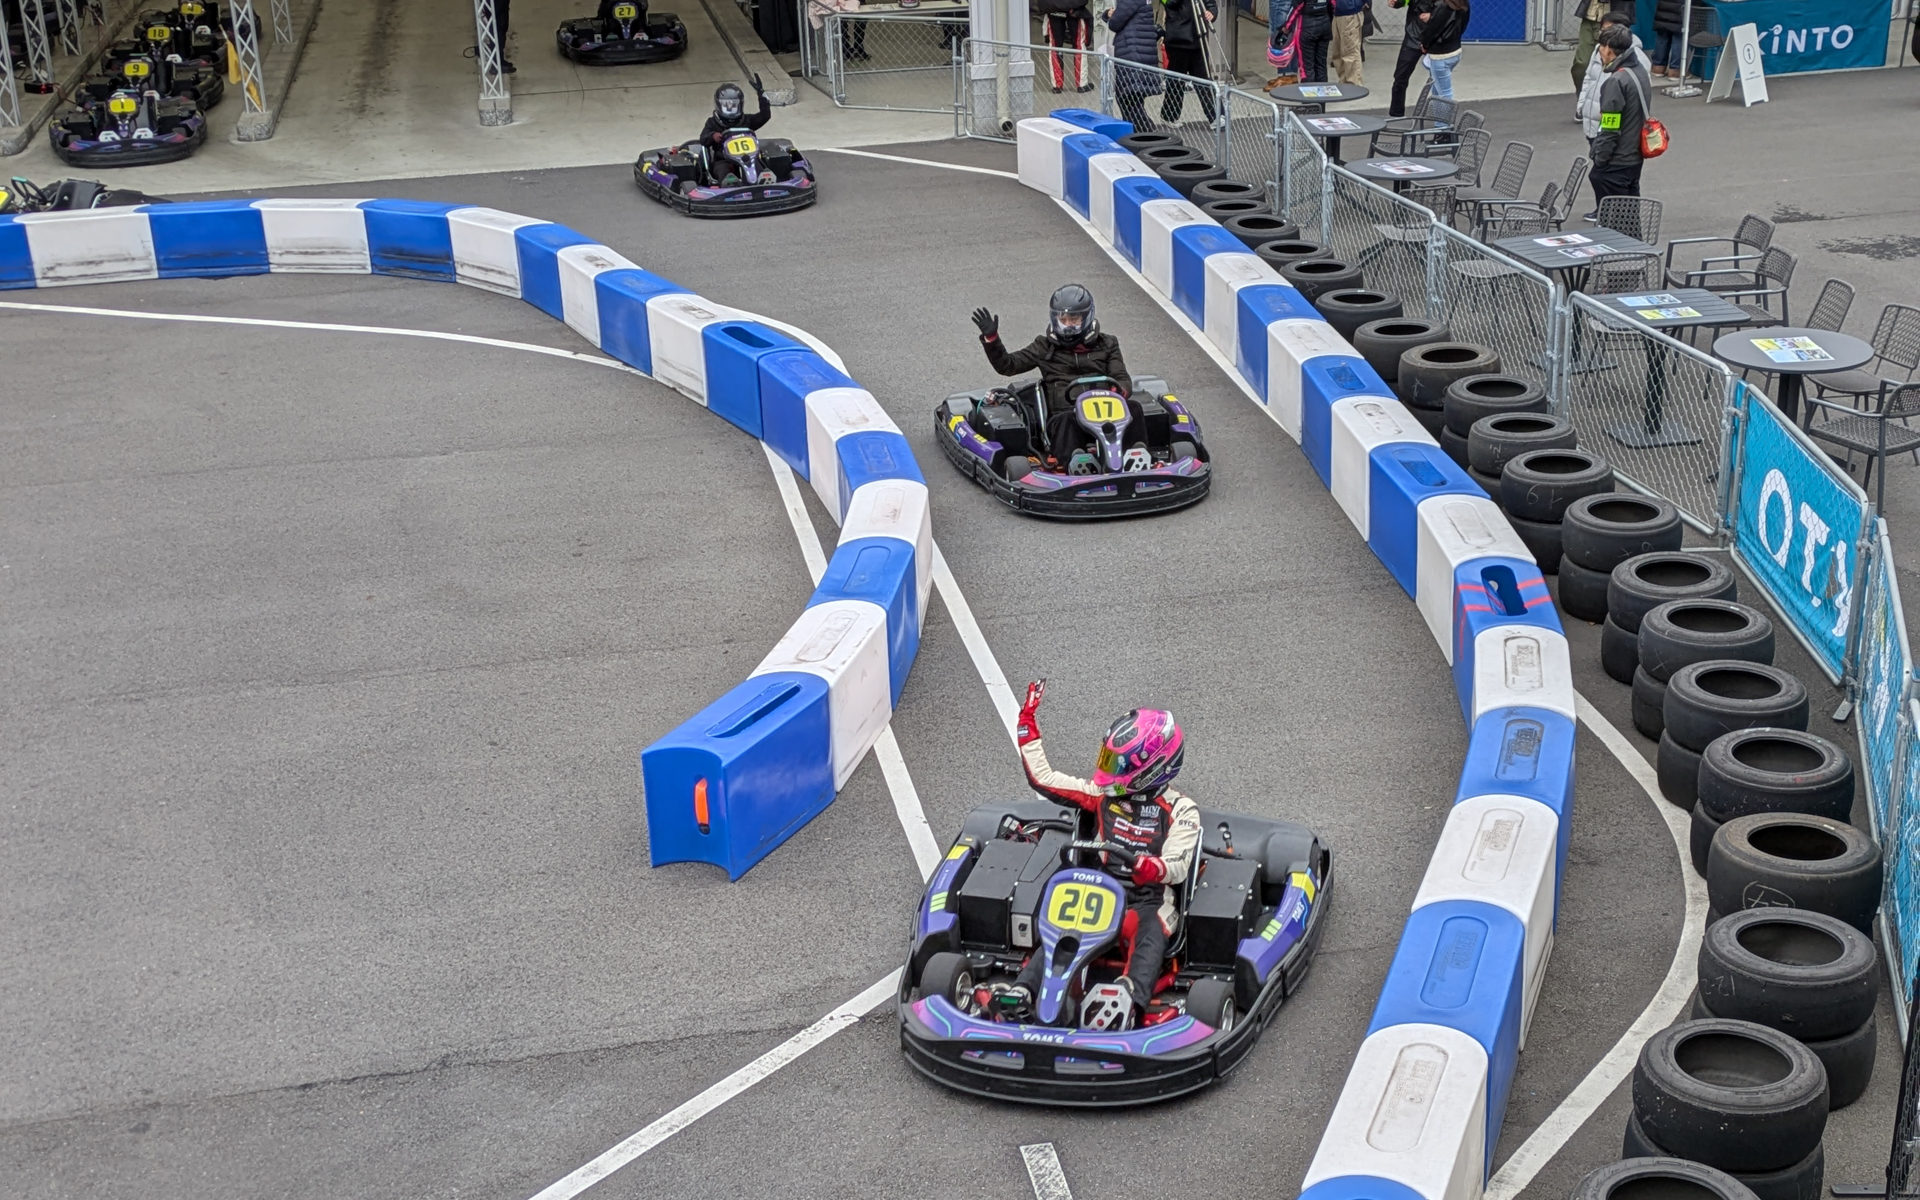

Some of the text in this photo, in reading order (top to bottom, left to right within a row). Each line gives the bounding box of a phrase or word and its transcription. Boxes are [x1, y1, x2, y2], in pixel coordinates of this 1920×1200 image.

[618, 7, 632, 16] 27
[153, 29, 165, 38] 18
[132, 64, 140, 73] 9
[734, 140, 750, 152] 16
[1093, 401, 1113, 418] 17
[1072, 872, 1103, 884] TOM'S
[1058, 888, 1103, 926] 29
